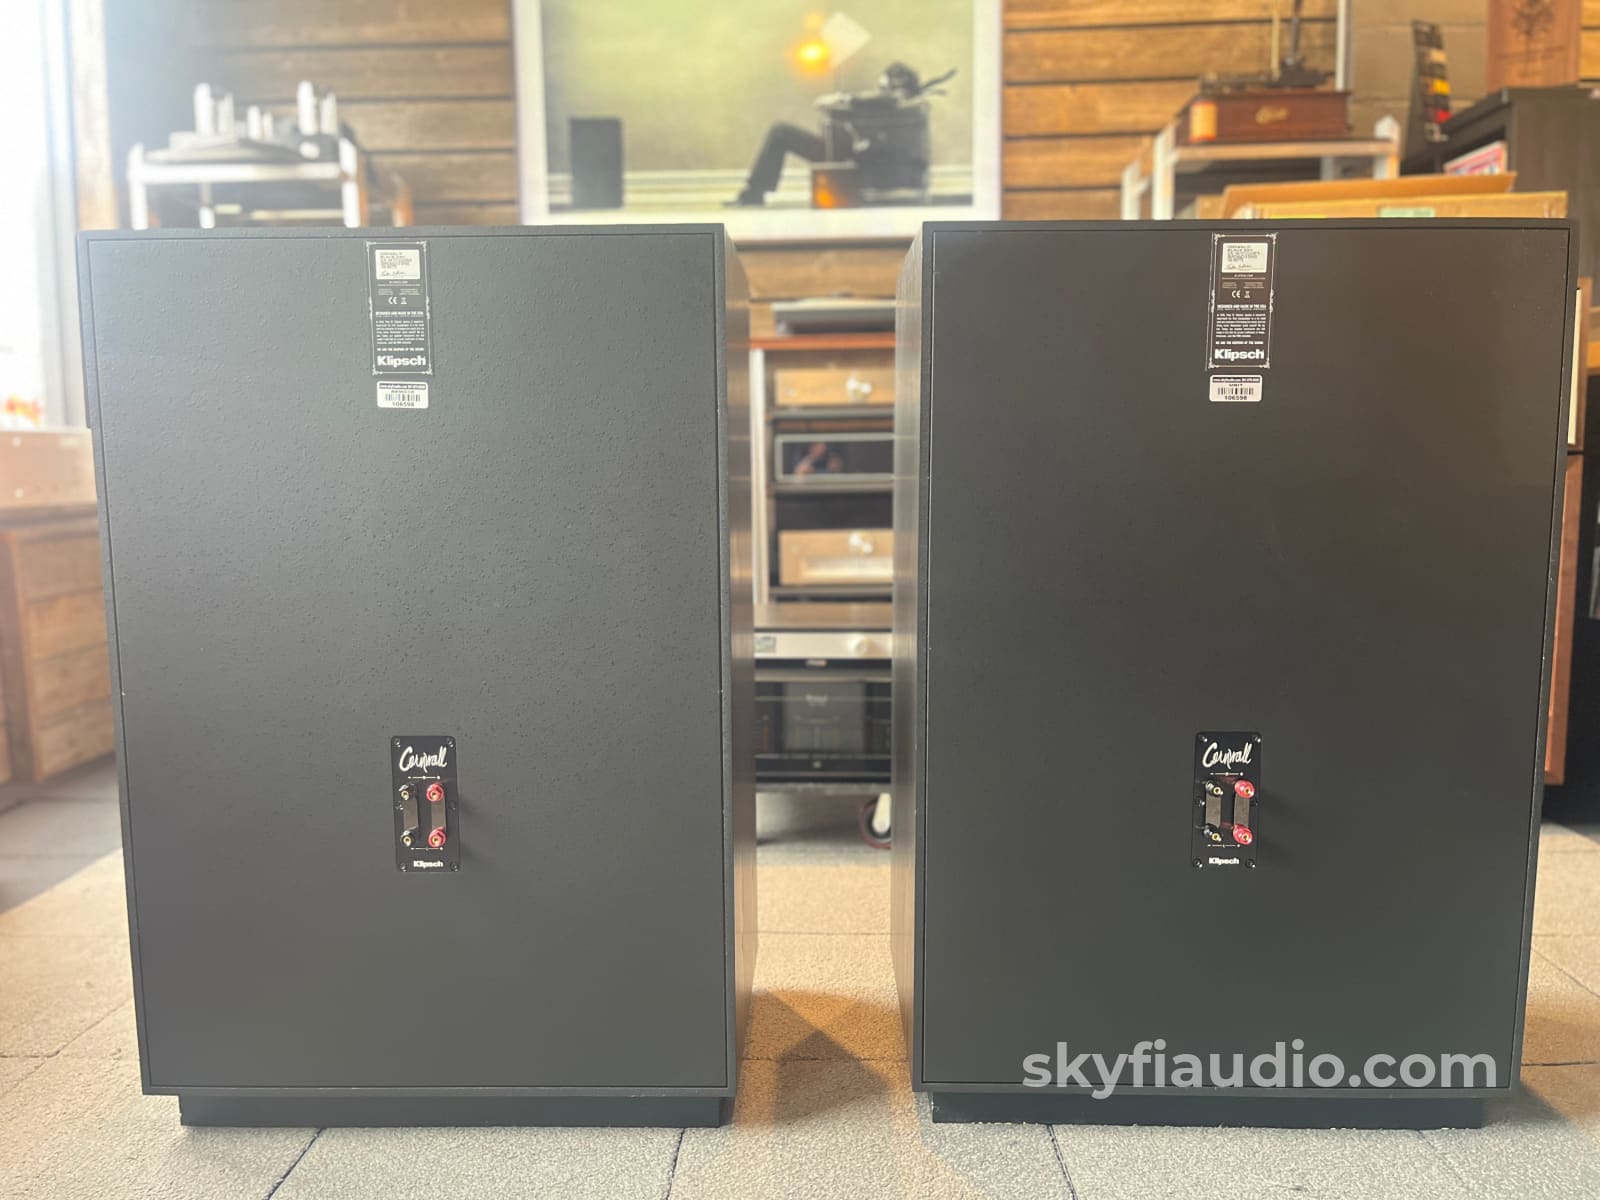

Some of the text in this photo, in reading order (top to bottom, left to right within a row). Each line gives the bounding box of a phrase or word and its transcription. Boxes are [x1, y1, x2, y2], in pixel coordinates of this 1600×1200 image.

[1215, 349, 1264, 361] Klipsch
[377, 356, 426, 367] Klipsch
[413, 860, 444, 869] Klipsch
[1208, 857, 1240, 866] Klipsch
